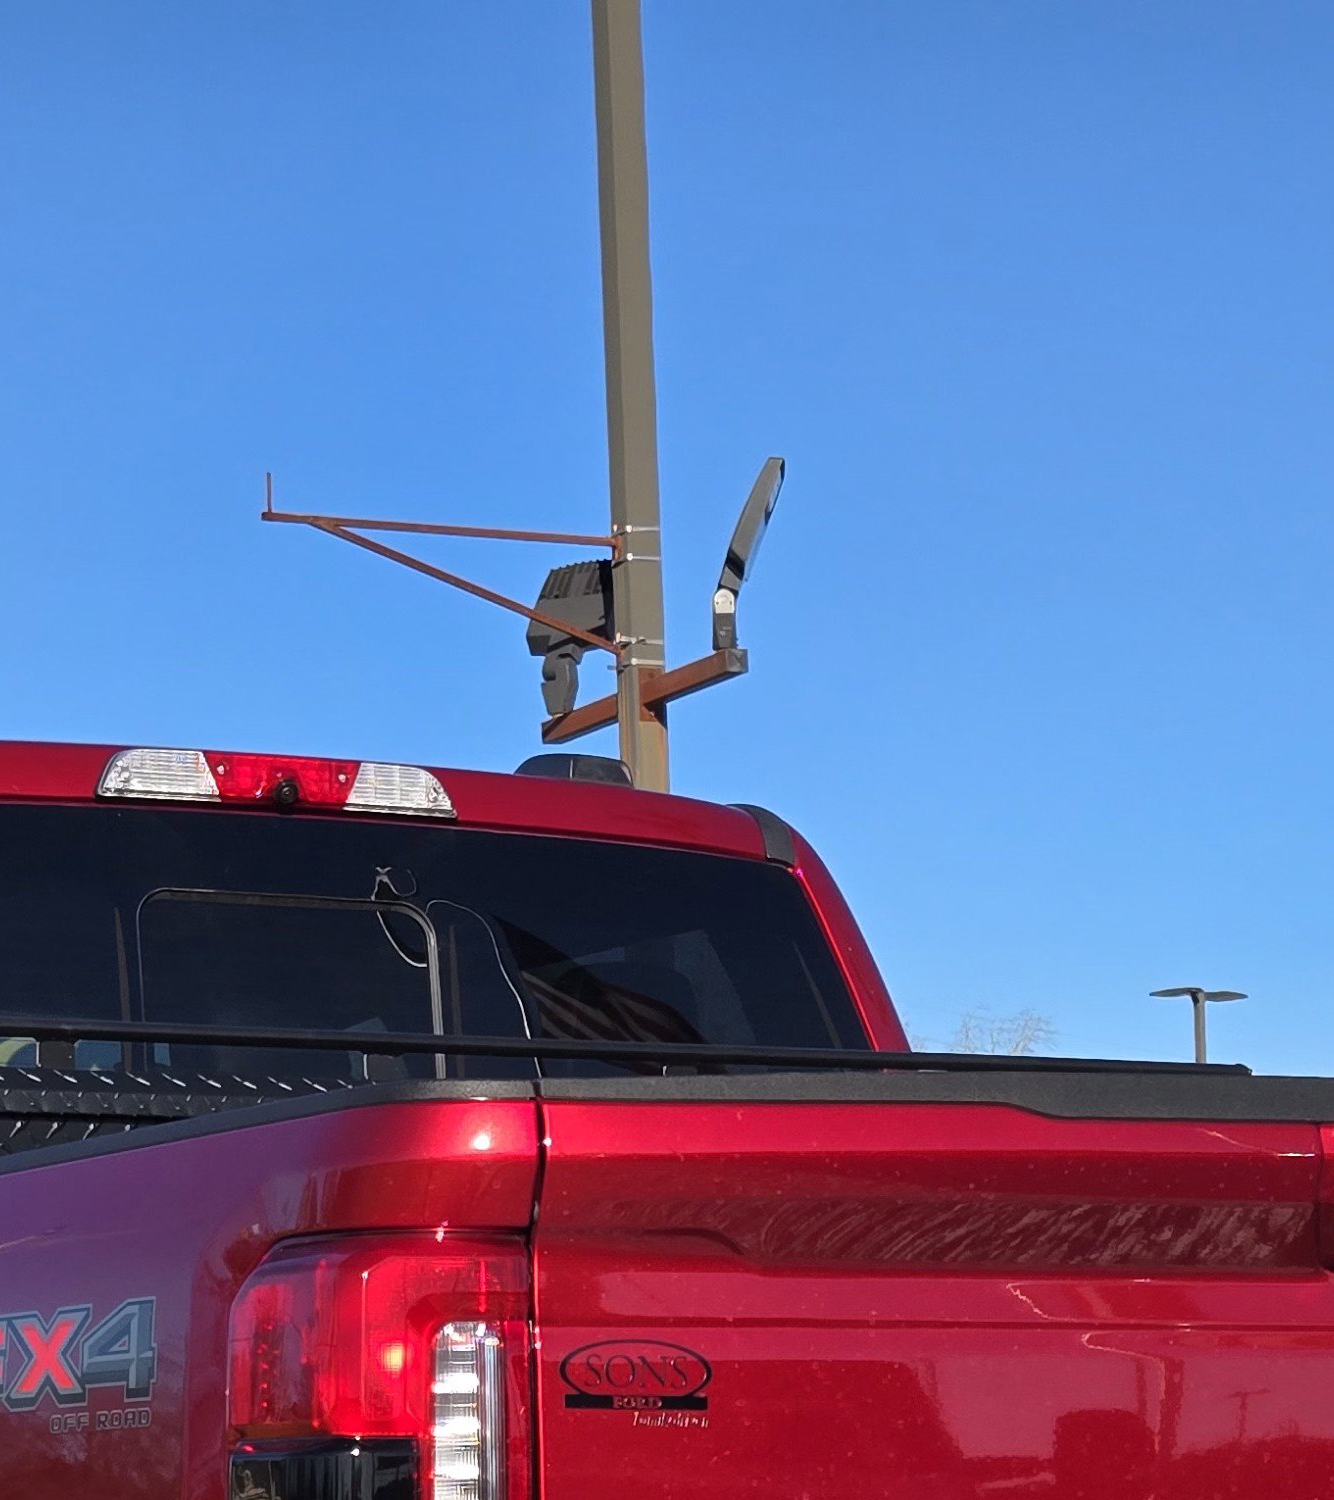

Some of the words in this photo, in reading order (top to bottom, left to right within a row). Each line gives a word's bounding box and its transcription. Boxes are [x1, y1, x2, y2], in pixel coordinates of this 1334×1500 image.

[584, 1354, 688, 1390] SONS
[50, 1413, 89, 1433] OFF
[96, 1408, 151, 1430] ROAD
